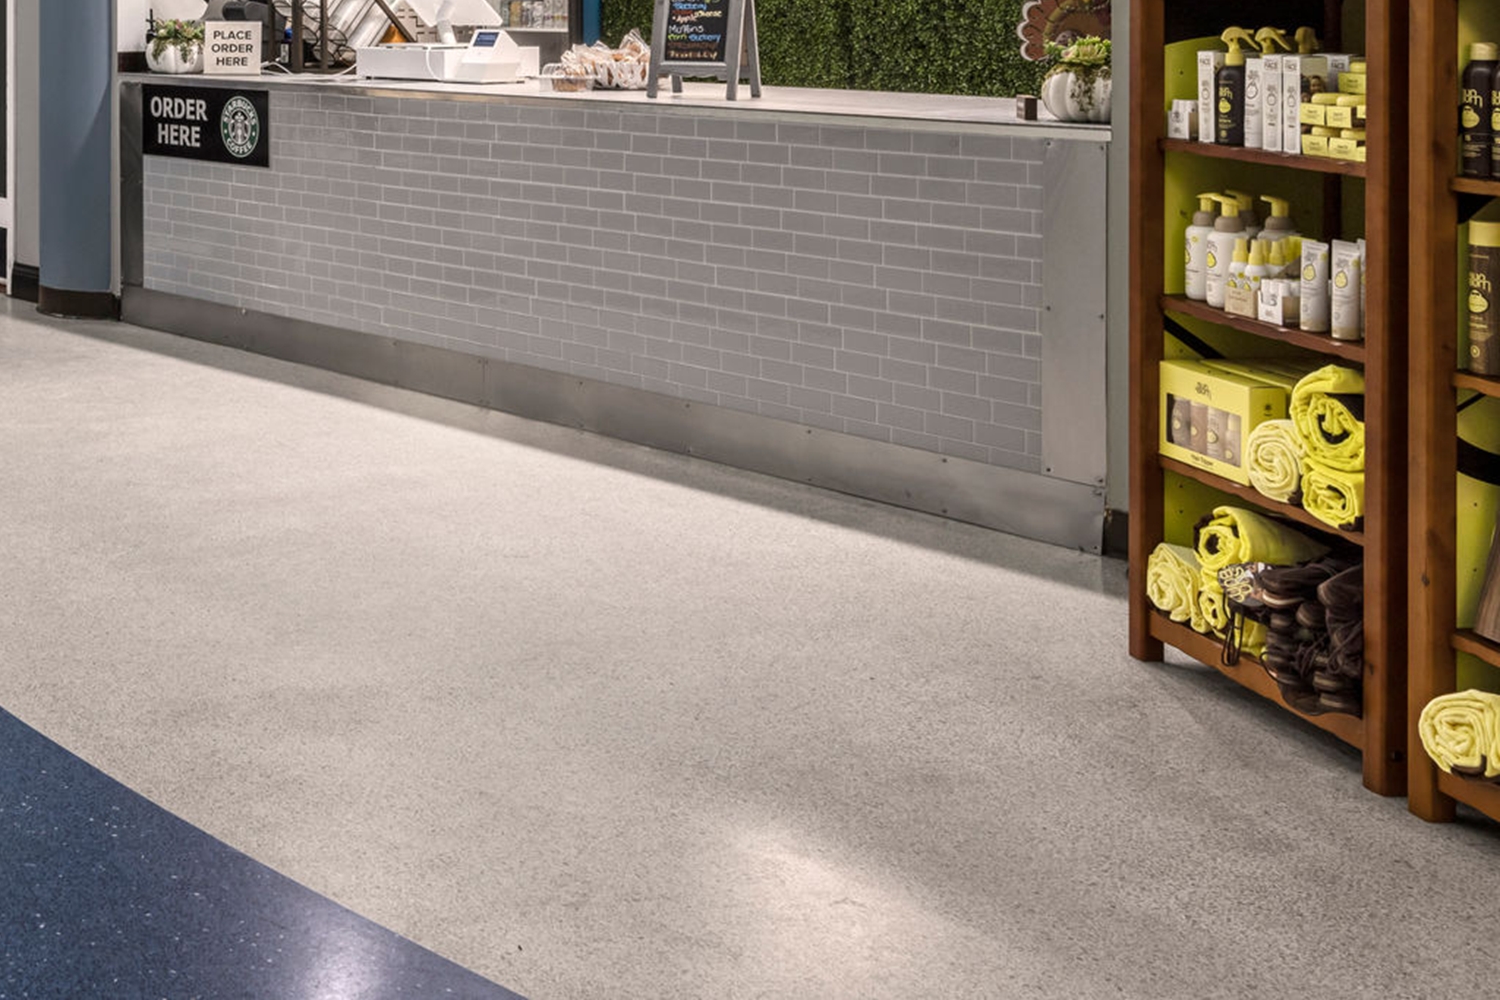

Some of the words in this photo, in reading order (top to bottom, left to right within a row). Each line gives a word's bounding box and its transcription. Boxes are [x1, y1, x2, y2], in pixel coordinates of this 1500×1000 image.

[213, 30, 252, 40] PLACE
[211, 43, 253, 53] ORDER
[216, 56, 248, 66] HERE
[150, 96, 208, 121] ORDER
[223, 99, 256, 125] STARBUCKS
[157, 123, 200, 147] HERE
[226, 138, 252, 154] COFFEE
